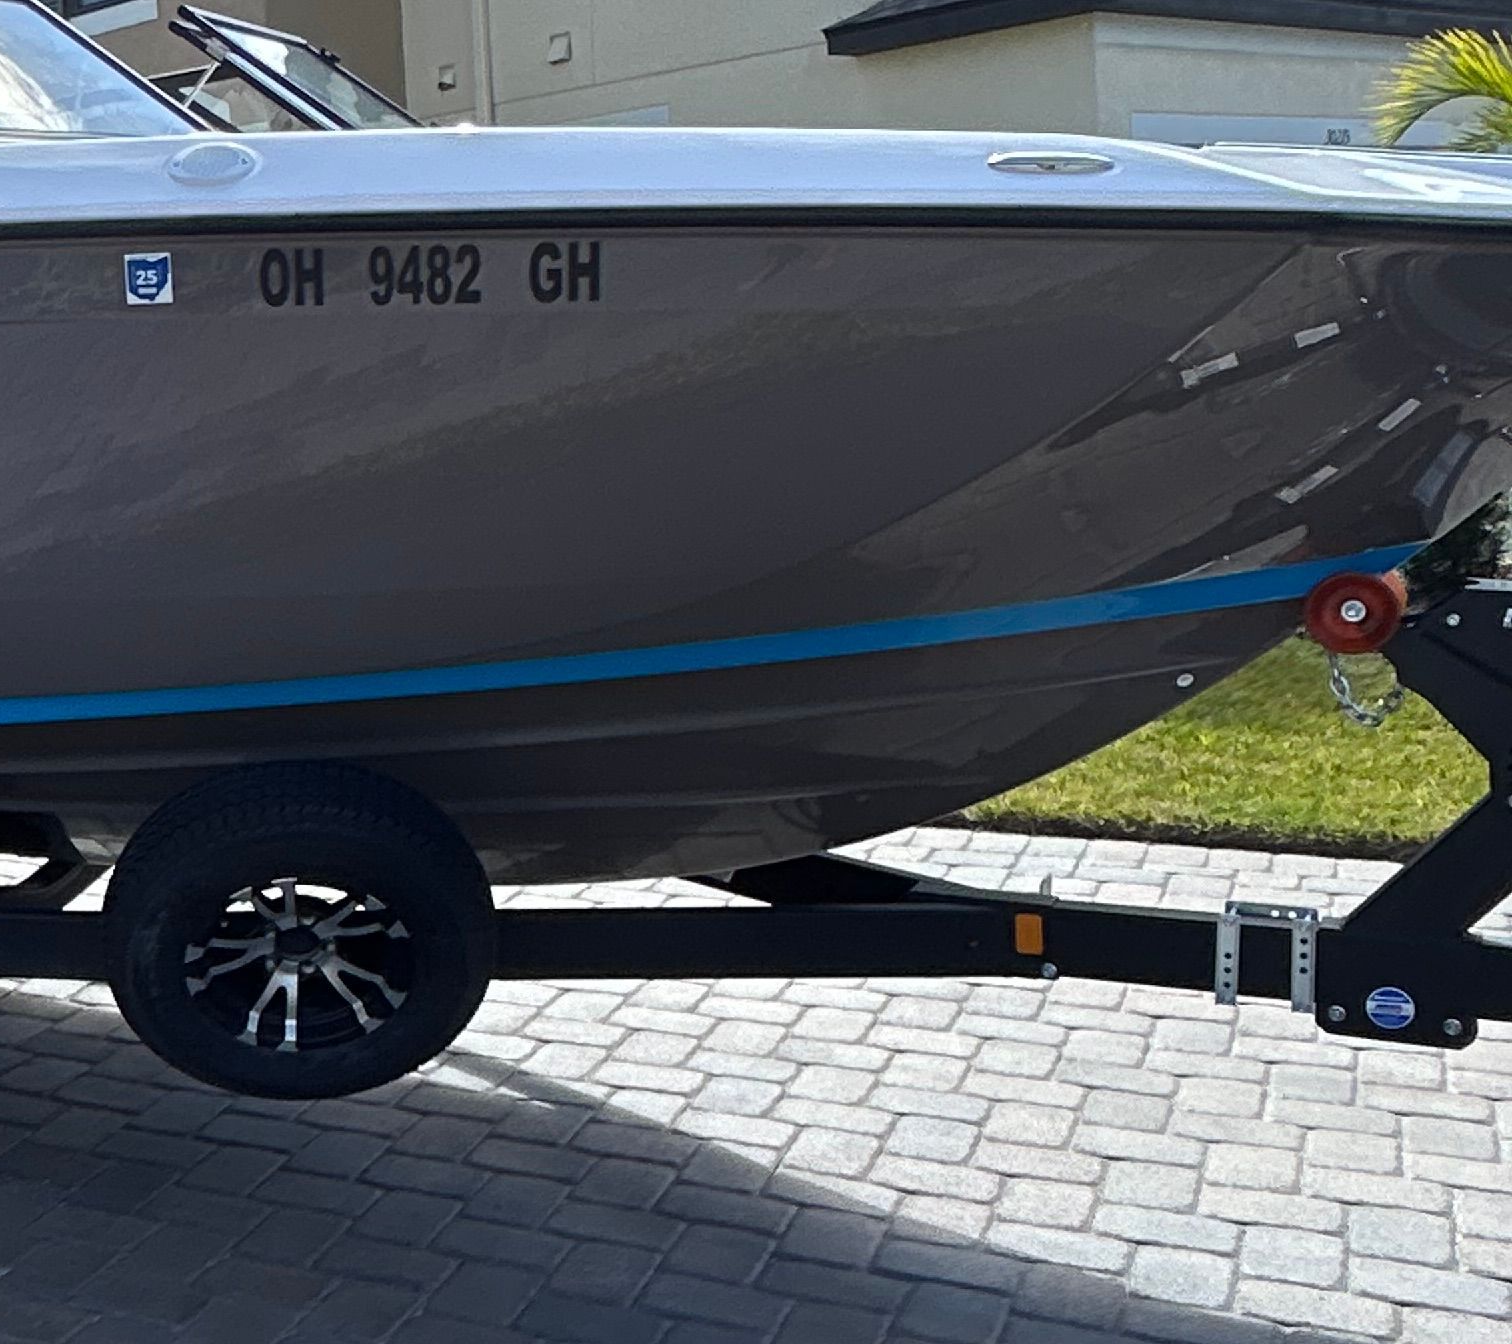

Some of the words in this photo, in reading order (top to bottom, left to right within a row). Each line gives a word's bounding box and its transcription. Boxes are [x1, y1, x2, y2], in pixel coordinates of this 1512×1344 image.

[135, 269, 158, 286] 25
[260, 247, 324, 307] OH
[368, 243, 482, 305] 9482
[529, 241, 600, 303] GH
